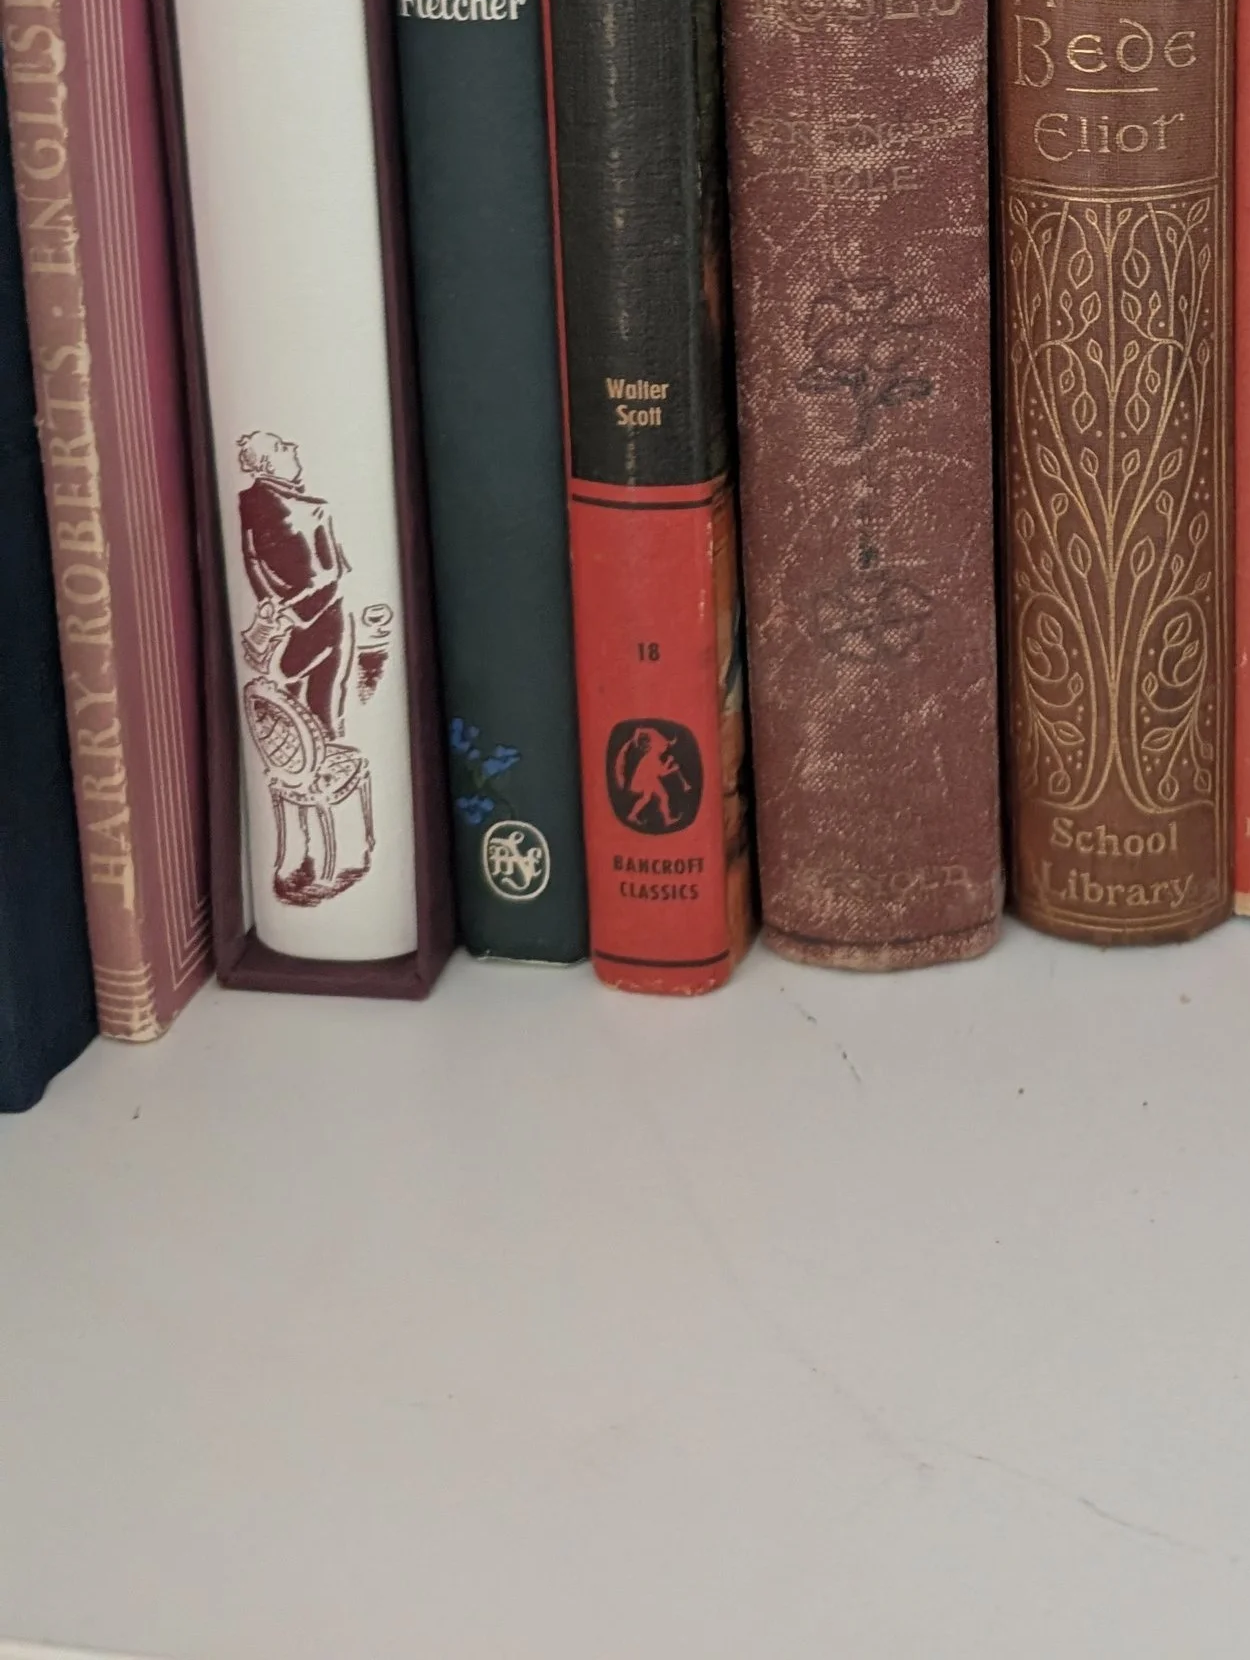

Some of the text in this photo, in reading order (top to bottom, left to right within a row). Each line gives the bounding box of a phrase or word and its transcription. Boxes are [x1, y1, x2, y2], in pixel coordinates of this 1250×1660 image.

[1013, 14, 1198, 88] Bede
[1033, 112, 1185, 162] Eliot
[605, 377, 670, 400] Walter
[615, 404, 663, 426] Scott
[41, 342, 113, 648] ROBERTS
[637, 643, 661, 662] 18
[75, 672, 135, 902] HARRY
[1050, 816, 1178, 856] School
[612, 855, 705, 874] BANCROFT
[1040, 859, 1194, 908] Library
[620, 881, 699, 901] CLASSICS
